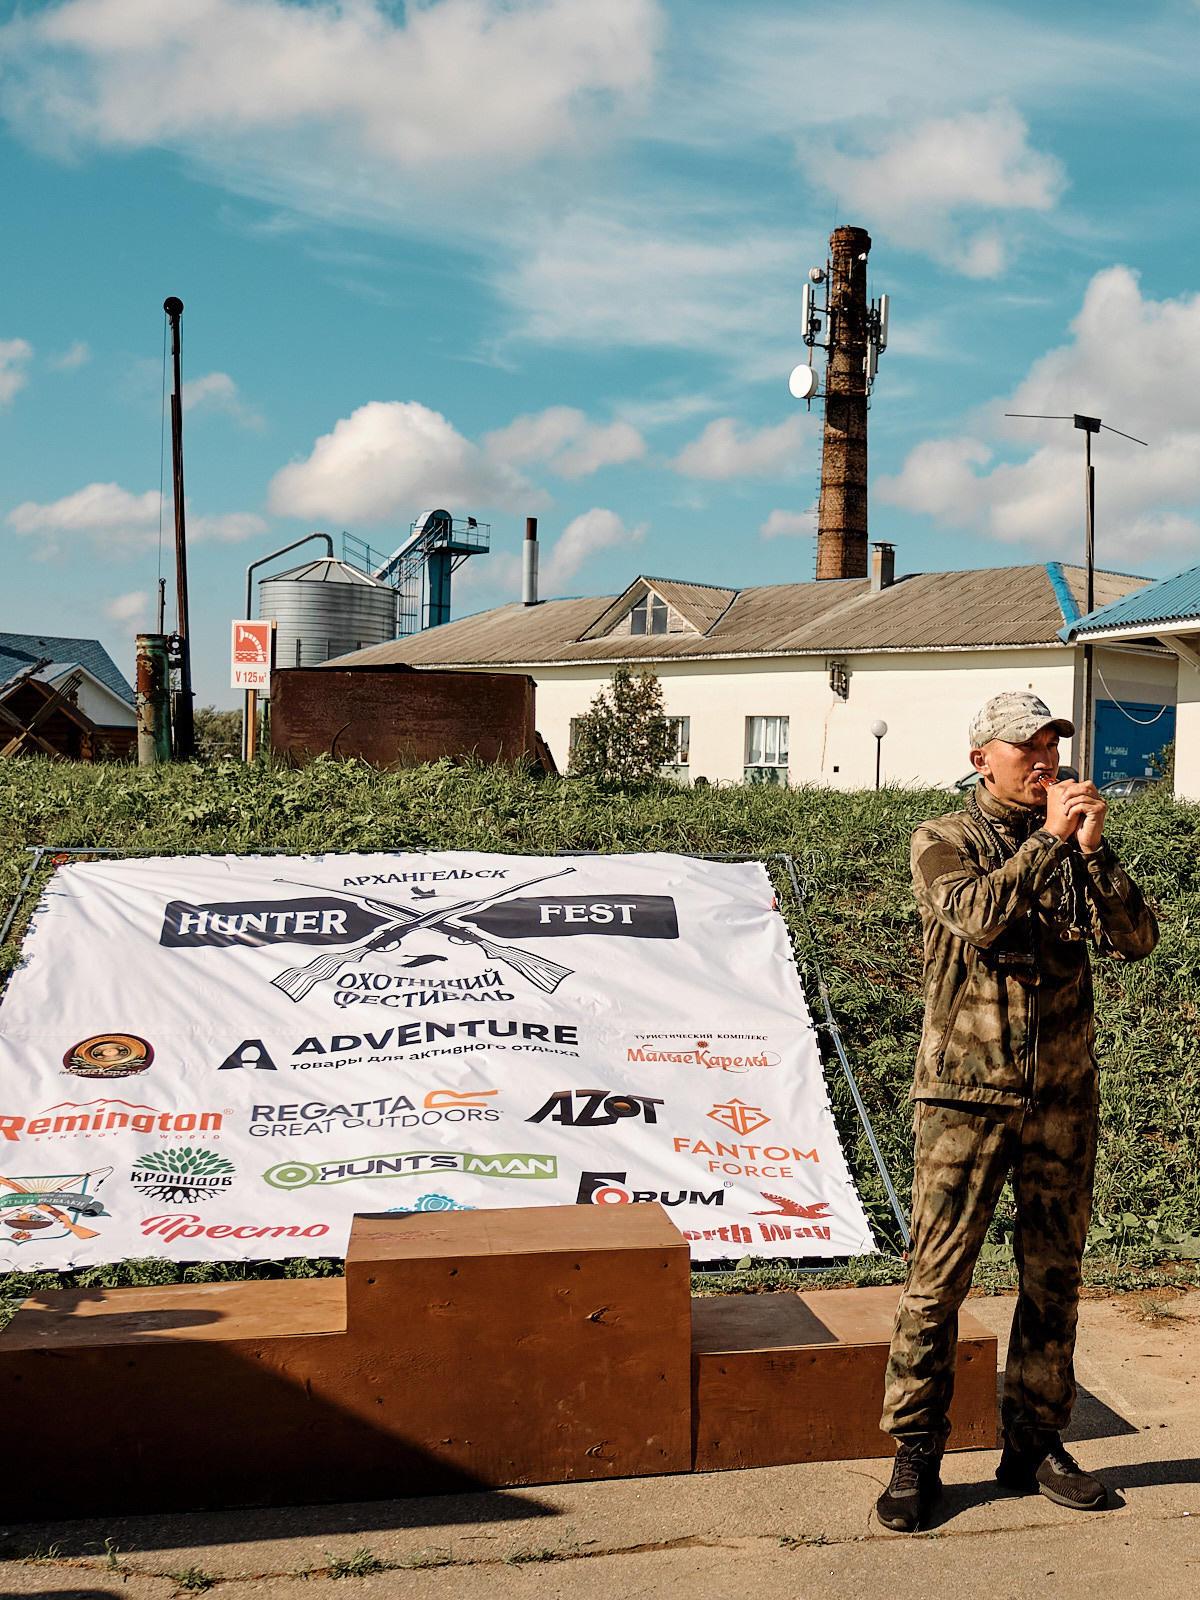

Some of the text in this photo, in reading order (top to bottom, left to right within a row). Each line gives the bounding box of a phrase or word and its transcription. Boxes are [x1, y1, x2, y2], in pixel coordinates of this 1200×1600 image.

[243, 671, 258, 683] 125
[343, 869, 510, 886] АРХАНГЕЛЬСК
[178, 903, 637, 936] HUNTER FEST
[336, 967, 505, 990] ОХОТНИЧИЙ
[333, 990, 515, 1008] ФЕСТИВАЛЬ
[291, 1019, 579, 1056] ADVENTURE
[717, 1033, 768, 1041] КОМПЛЕКС
[289, 1042, 581, 1071] товары для активного отдыха
[250, 1095, 416, 1122] REGATTA
[523, 1089, 665, 1127] AZOT
[249, 1108, 500, 1137] GREAT OUTDOORS
[34, 1132, 119, 1142] SYNERGY
[672, 1137, 821, 1163] FANTOM
[708, 1160, 794, 1178] FORCE
[140, 1213, 330, 1243] Престо
[682, 1224, 753, 1244] orth
